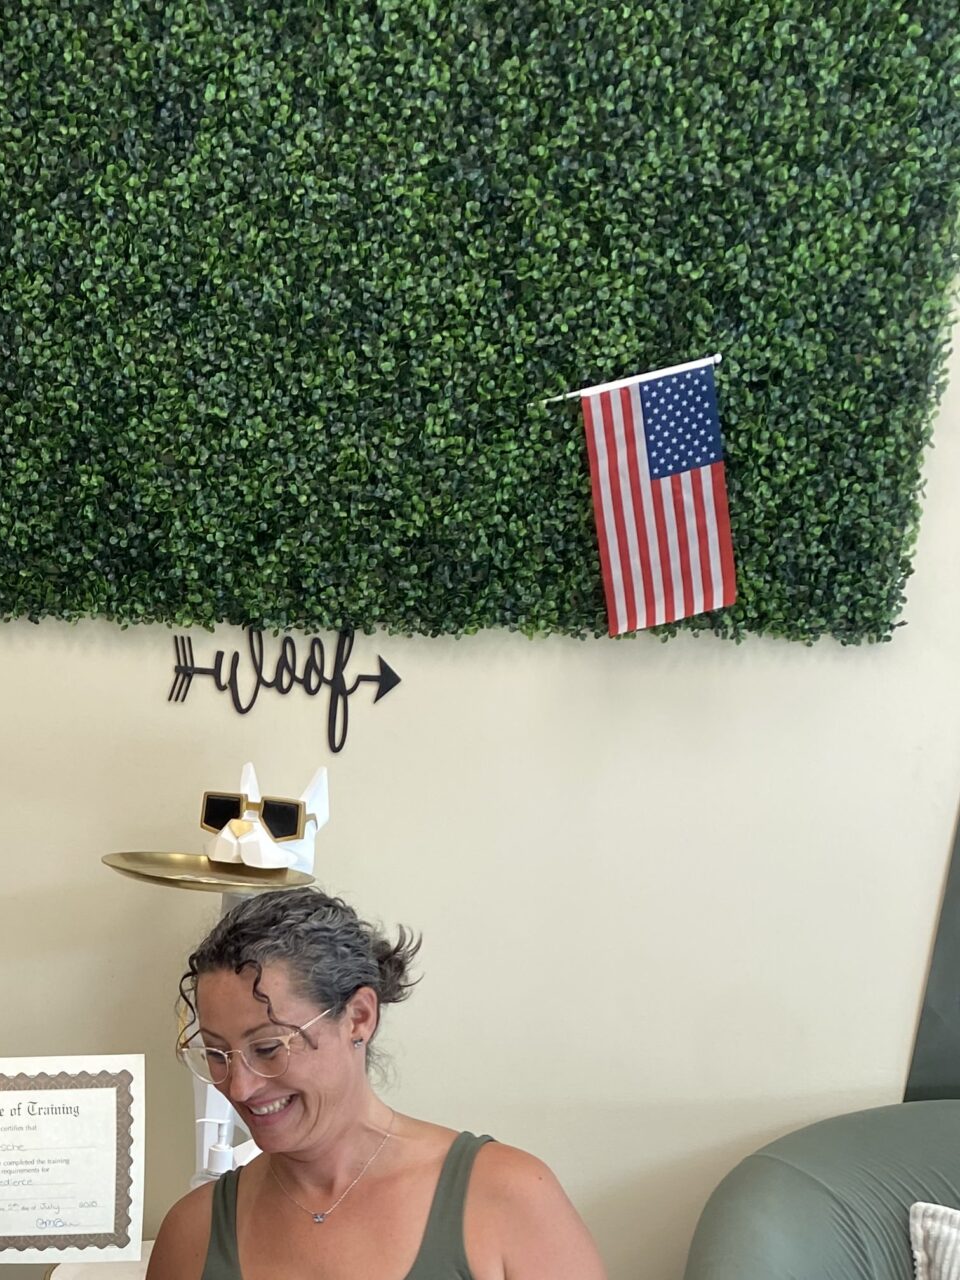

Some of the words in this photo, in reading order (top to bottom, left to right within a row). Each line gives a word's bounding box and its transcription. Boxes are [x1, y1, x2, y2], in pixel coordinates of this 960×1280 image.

[10, 1102, 23, 1116] of
[27, 1101, 80, 1118] Training
[3, 1159, 34, 1167] completed
[47, 1158, 70, 1166] training
[1, 1167, 40, 1176] requirements
